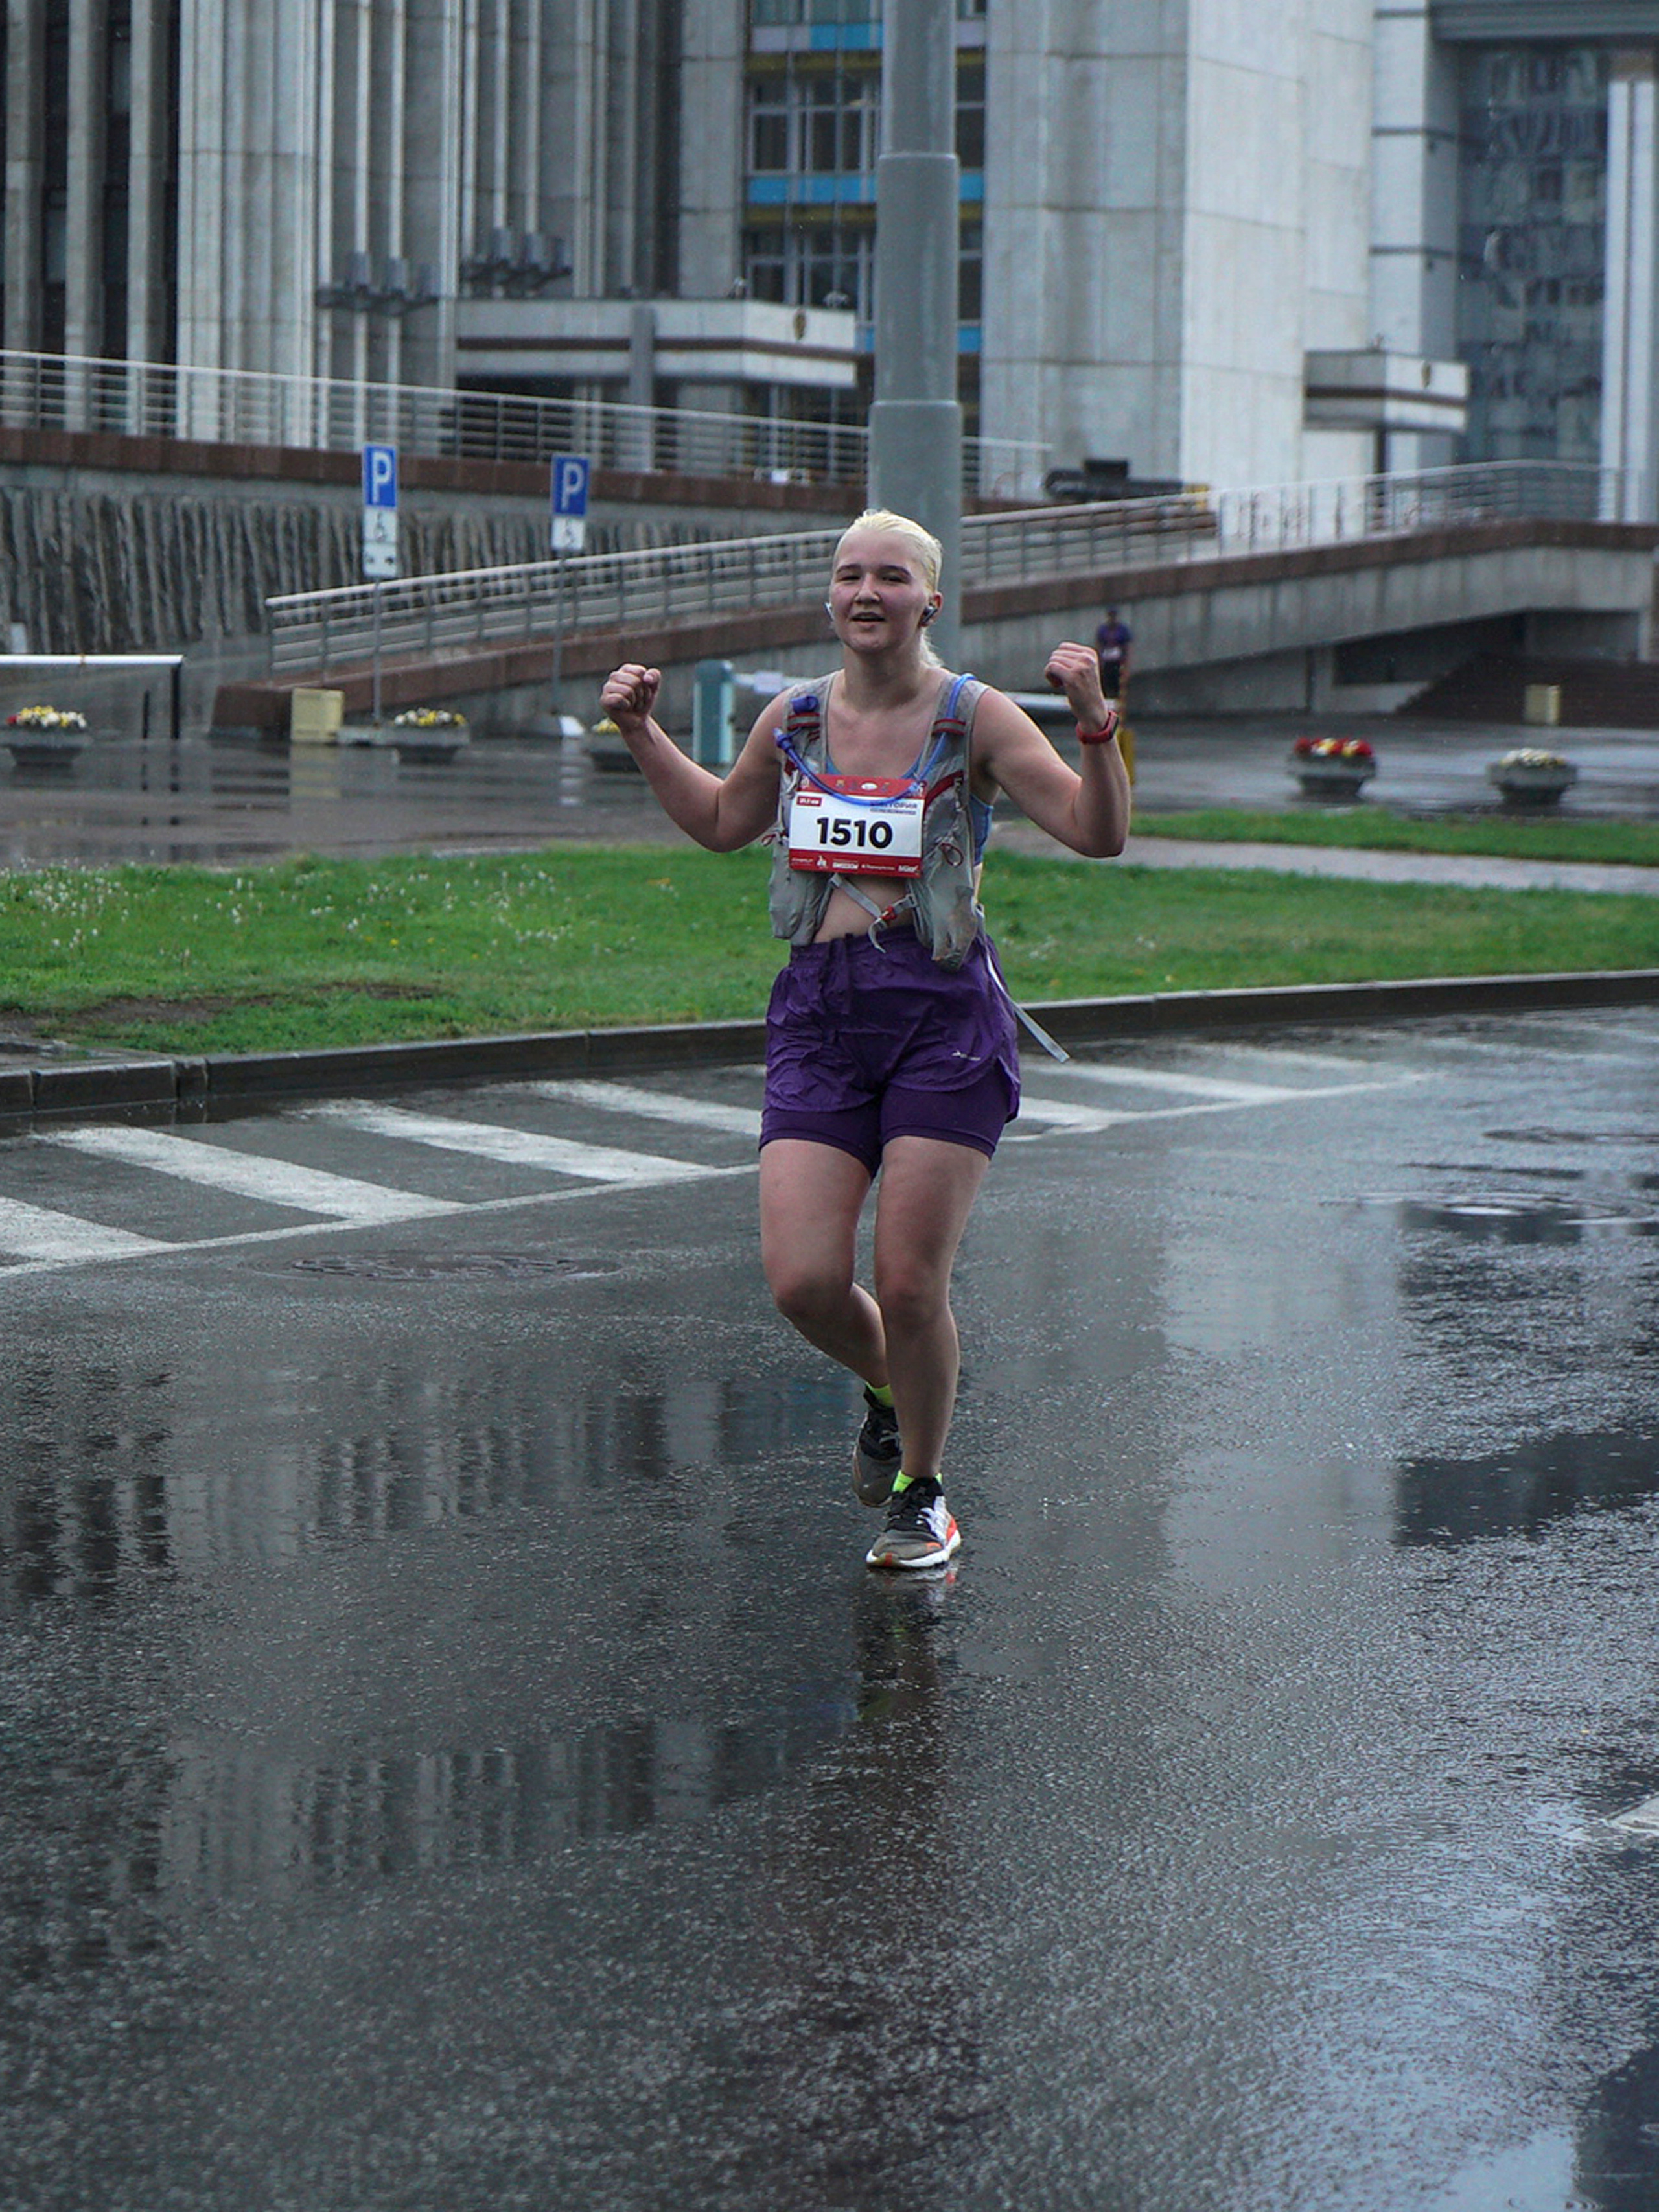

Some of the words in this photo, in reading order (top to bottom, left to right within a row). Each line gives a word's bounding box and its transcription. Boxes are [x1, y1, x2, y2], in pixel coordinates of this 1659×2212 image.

[372, 452, 392, 504] P
[561, 462, 584, 511] P
[817, 817, 893, 849] 1510
